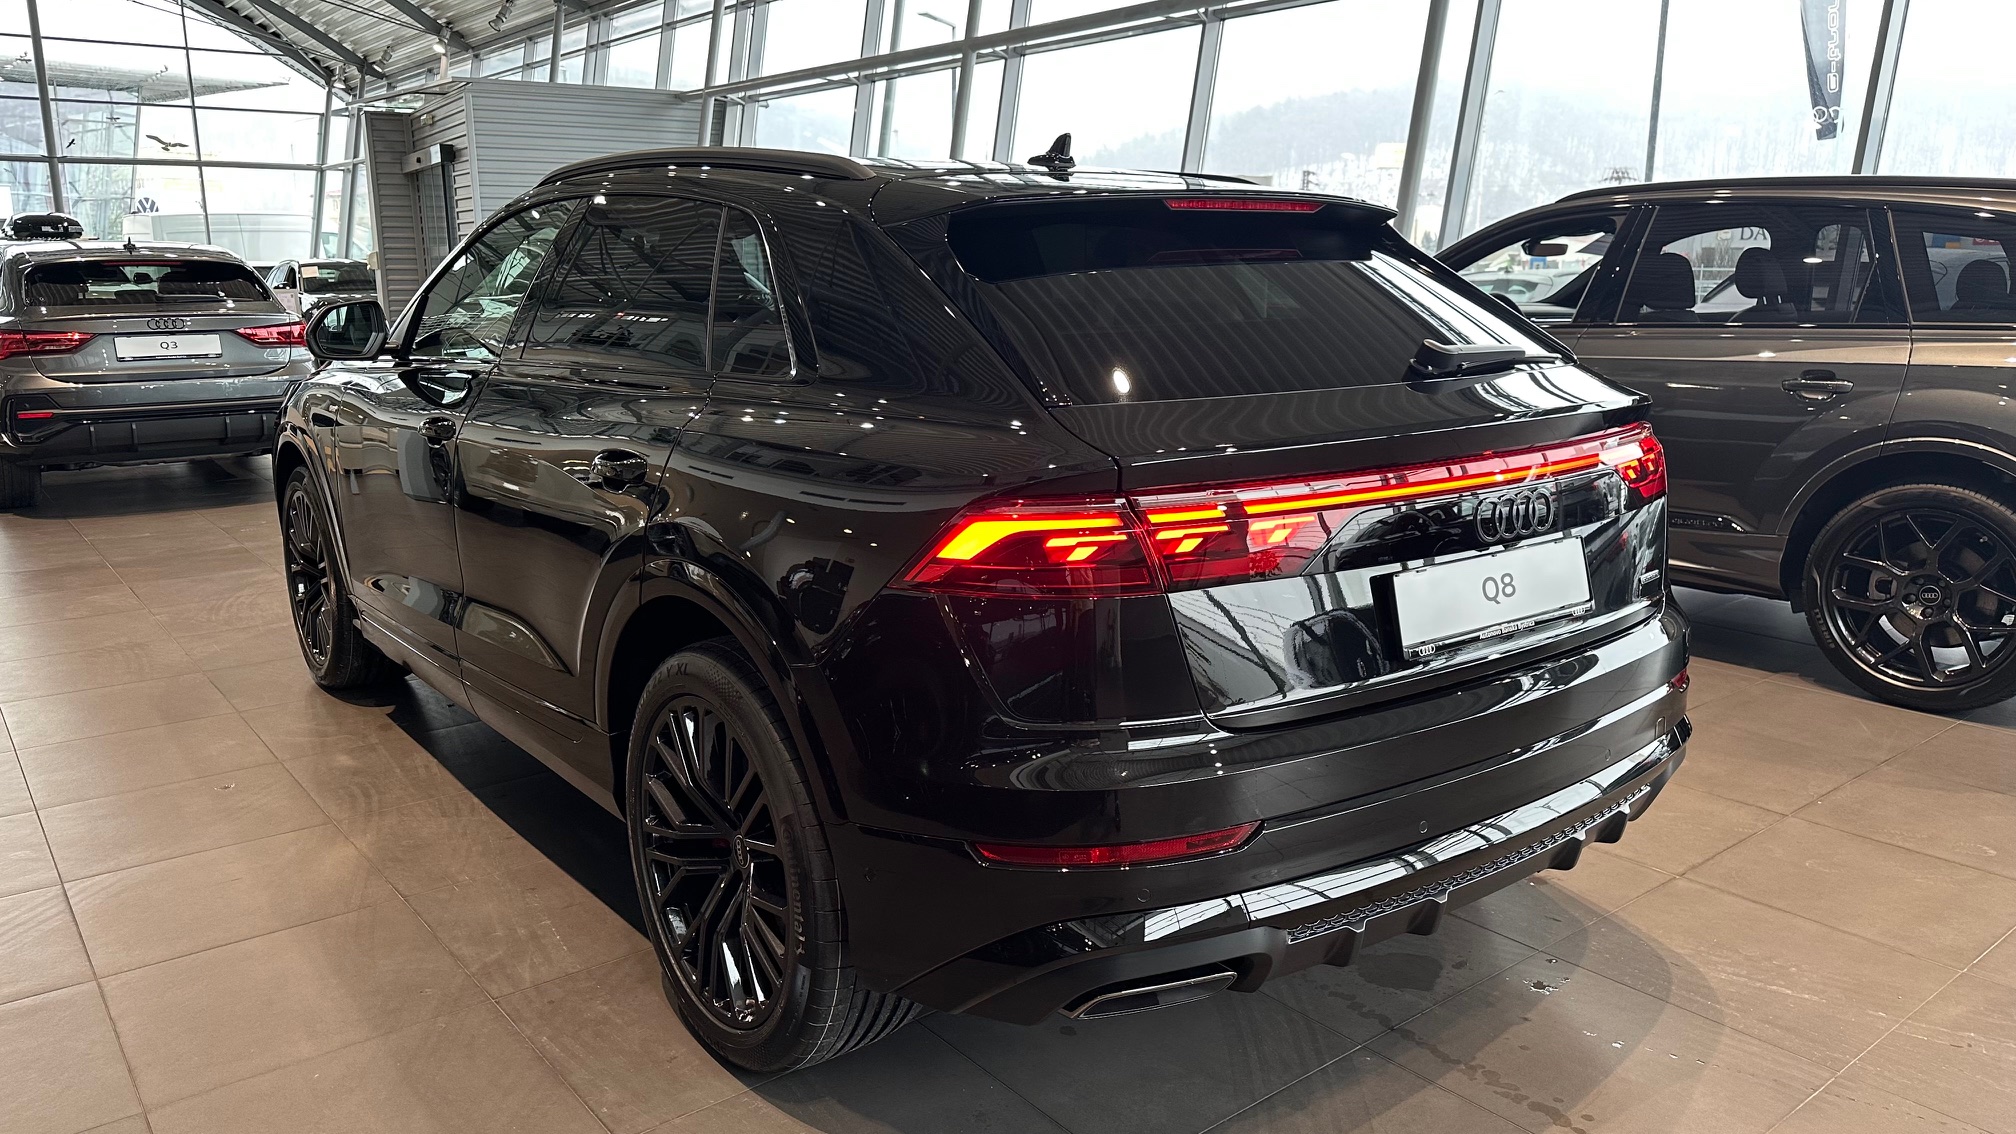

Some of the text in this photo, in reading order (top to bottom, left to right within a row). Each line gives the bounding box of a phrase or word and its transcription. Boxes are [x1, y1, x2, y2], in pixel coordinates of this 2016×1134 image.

[160, 341, 178, 350] Q3
[1482, 572, 1516, 604] Q8
[675, 663, 688, 676] XL
